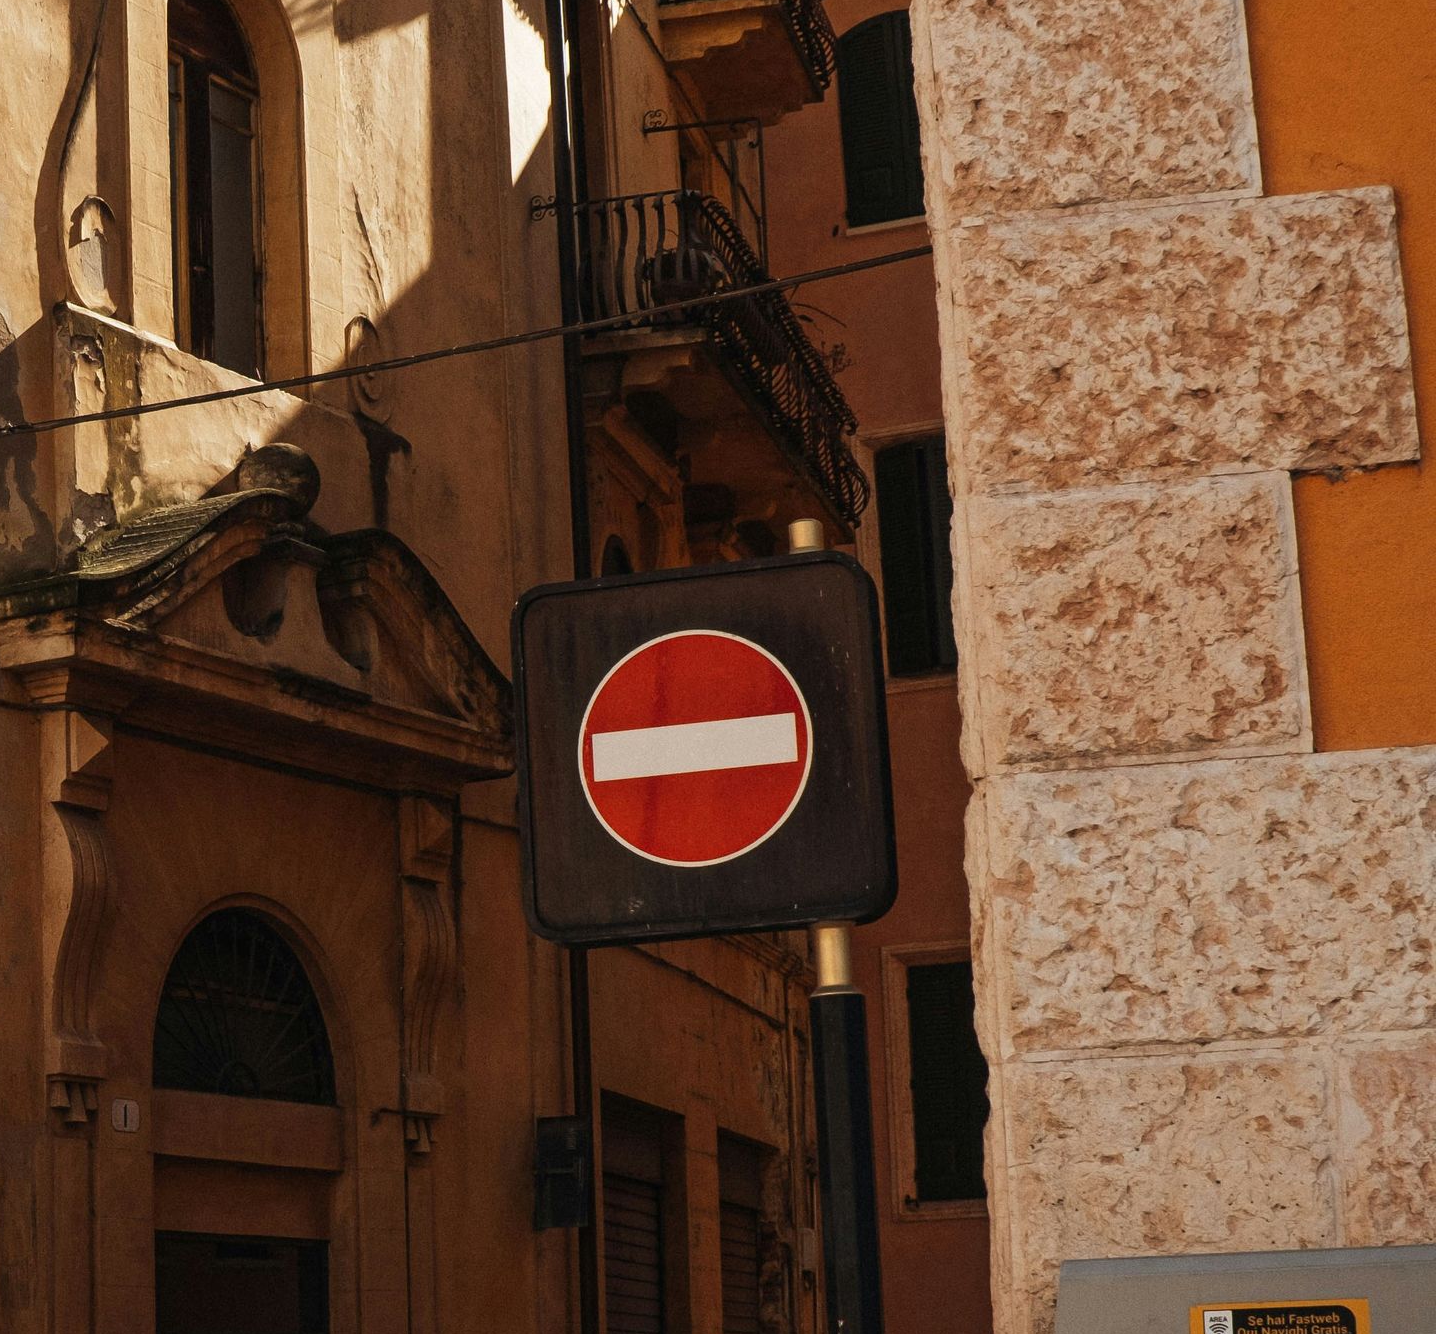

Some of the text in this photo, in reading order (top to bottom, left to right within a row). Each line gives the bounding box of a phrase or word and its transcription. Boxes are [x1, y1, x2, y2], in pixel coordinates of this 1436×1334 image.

[1247, 1312, 1340, 1326] Se hai Fastweb
